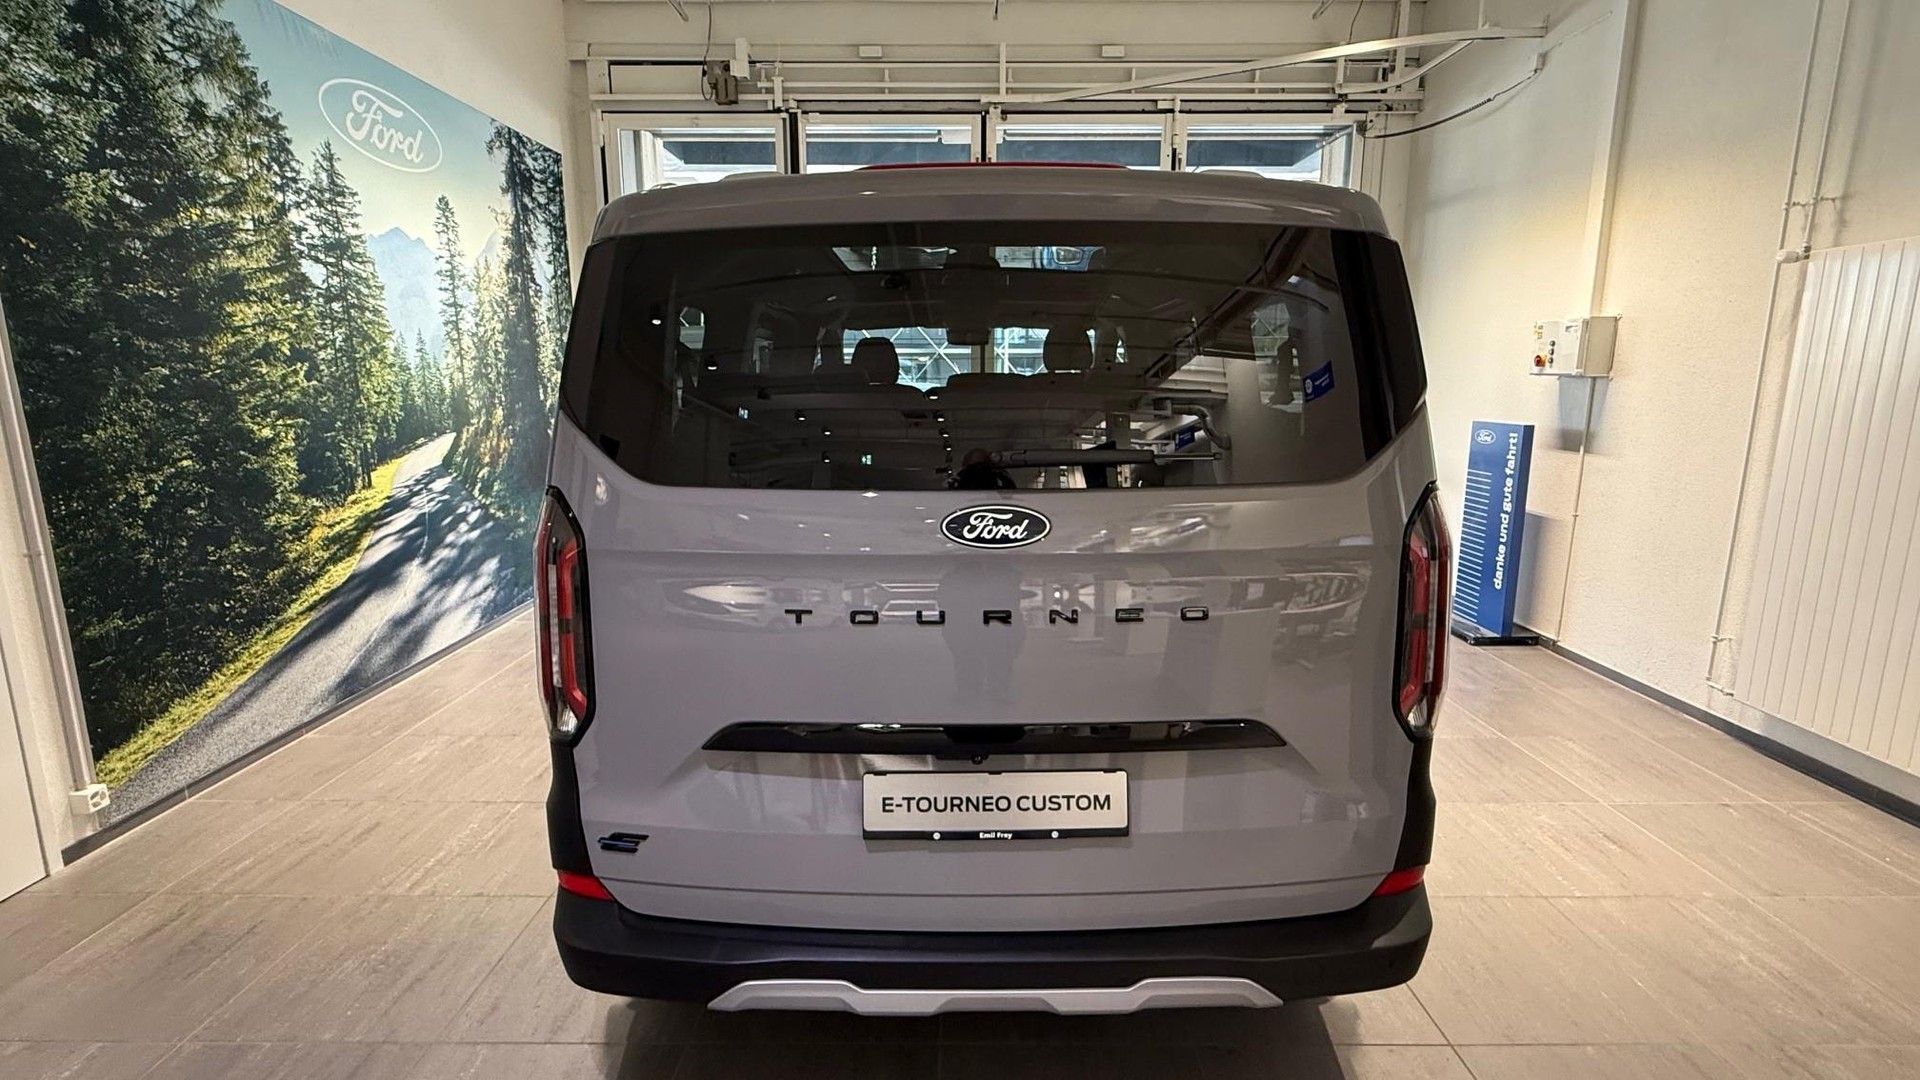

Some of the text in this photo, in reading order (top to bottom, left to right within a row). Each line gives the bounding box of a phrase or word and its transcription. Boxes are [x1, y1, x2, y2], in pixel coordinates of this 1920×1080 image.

[346, 90, 424, 164] Ford
[1493, 432, 1518, 590] danke und gute fahrt!
[962, 510, 1028, 541] Ford
[784, 606, 1210, 625] TOURNEO
[881, 794, 1112, 813] E-TOURNEO CUSTOM
[979, 831, 1013, 840] Emil Frey
